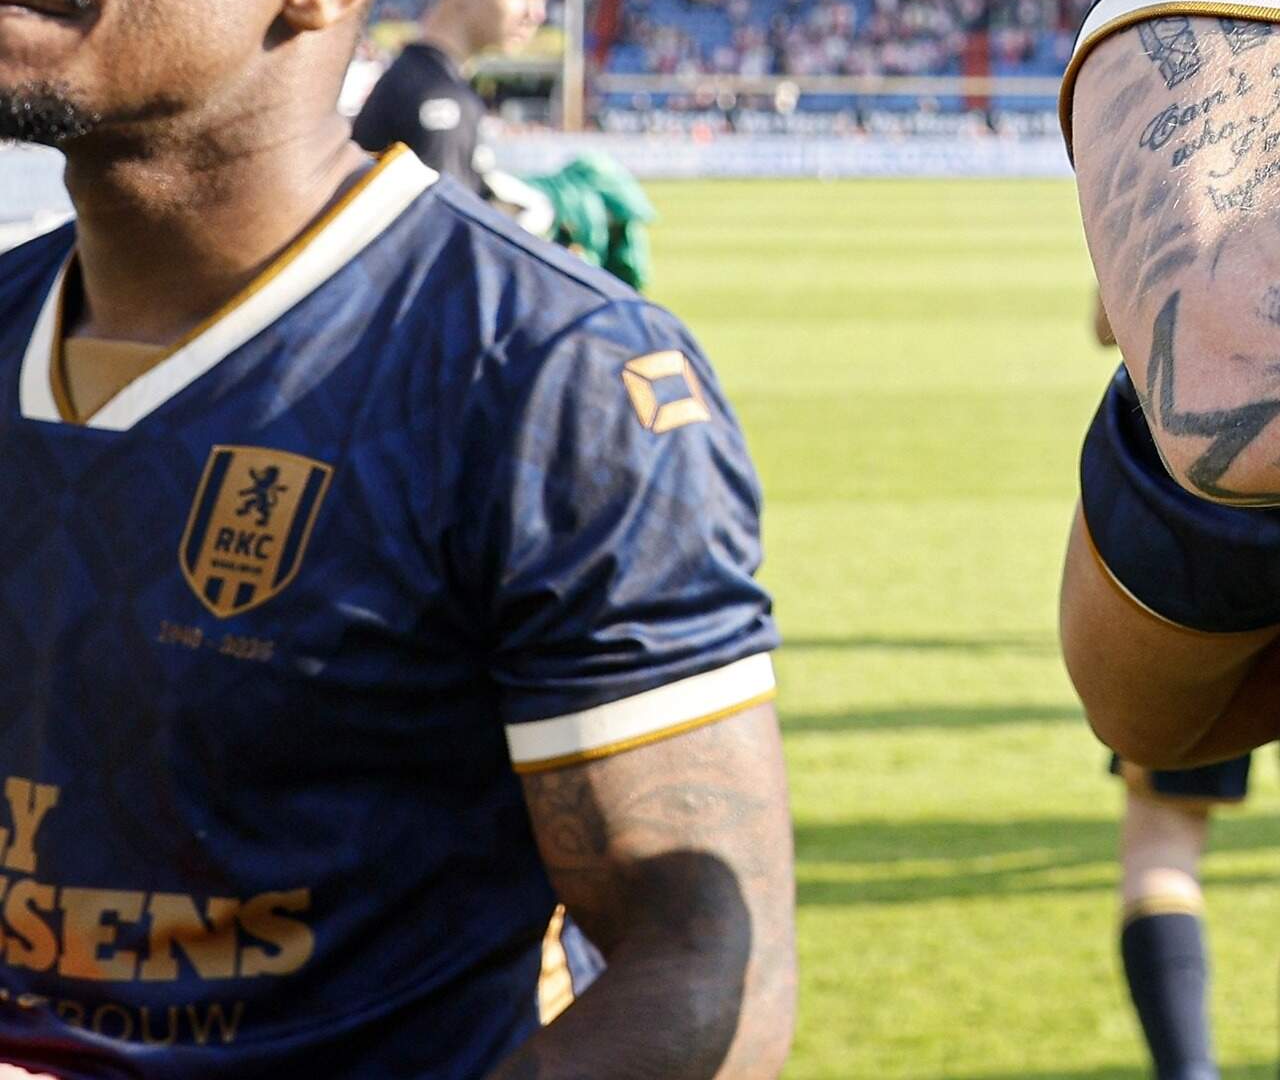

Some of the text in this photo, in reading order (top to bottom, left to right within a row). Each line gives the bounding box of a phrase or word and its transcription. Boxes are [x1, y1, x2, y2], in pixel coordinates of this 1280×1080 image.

[214, 527, 274, 561] RKC
[0, 776, 60, 875] Y
[0, 875, 315, 982] SENS
